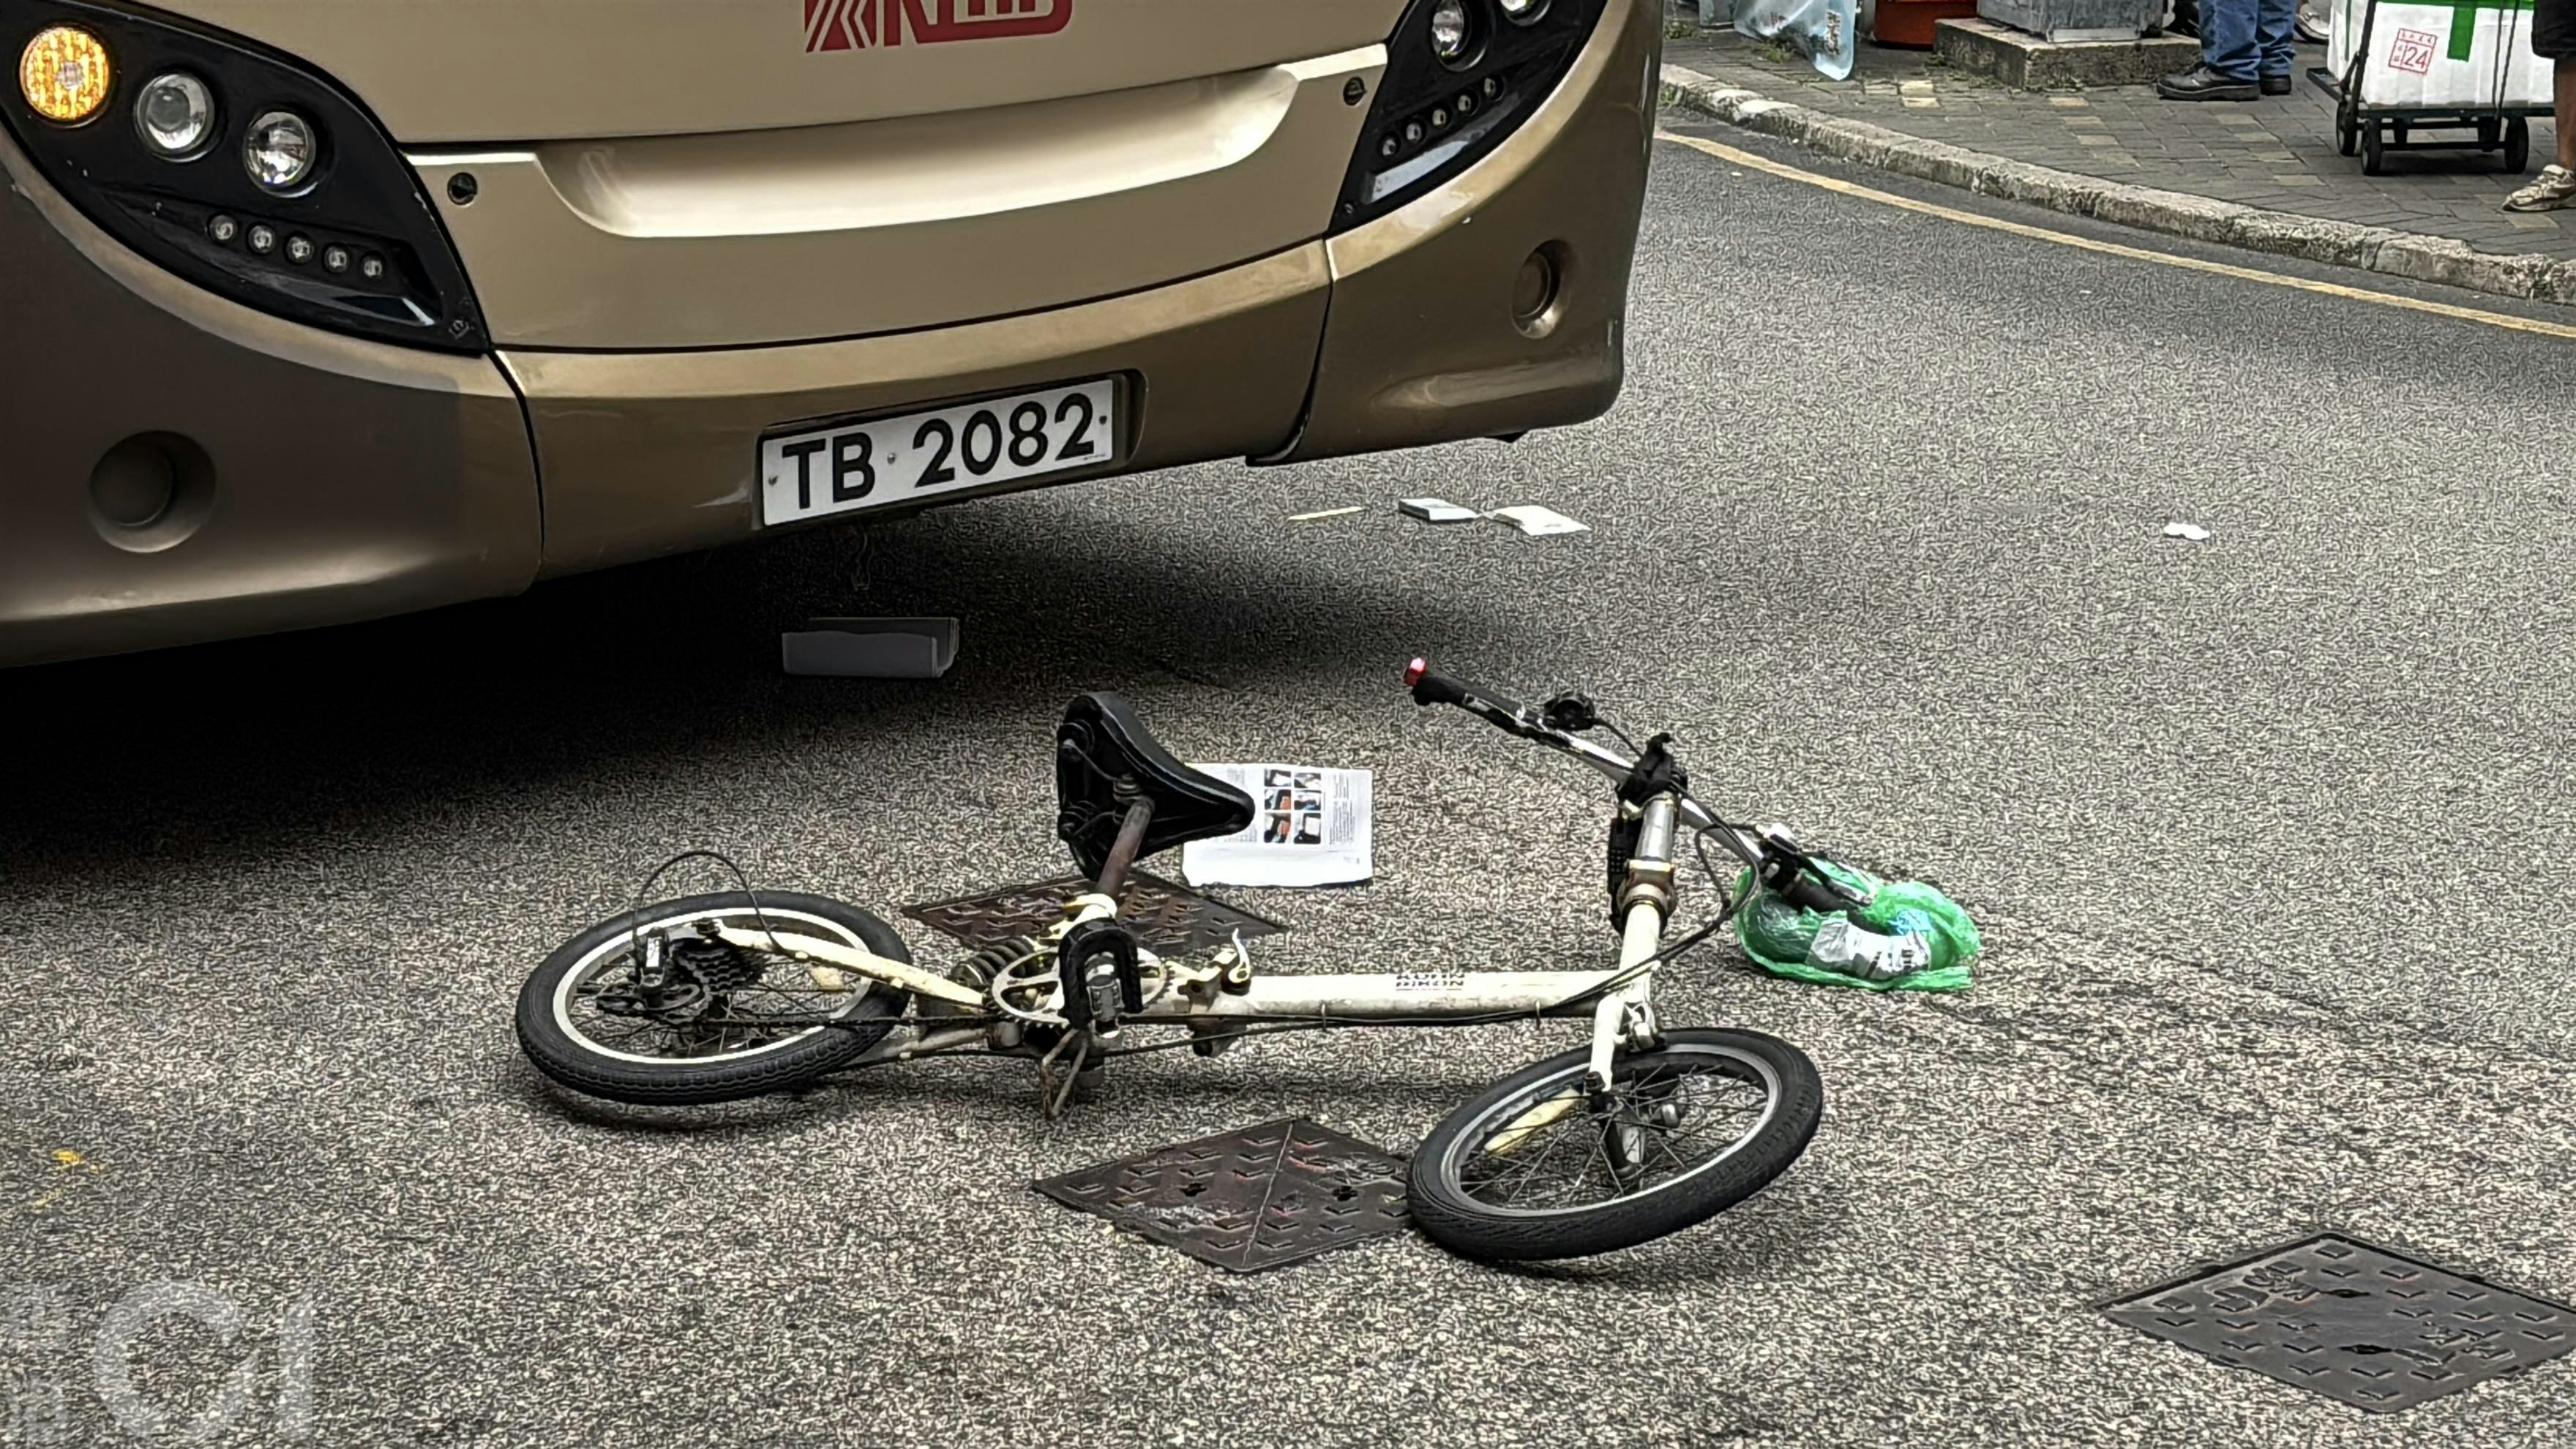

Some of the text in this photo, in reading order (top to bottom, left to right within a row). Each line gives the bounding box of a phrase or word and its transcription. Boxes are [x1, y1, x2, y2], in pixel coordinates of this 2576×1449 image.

[2404, 46, 2428, 68] 24
[782, 392, 1095, 509] TB 2082
